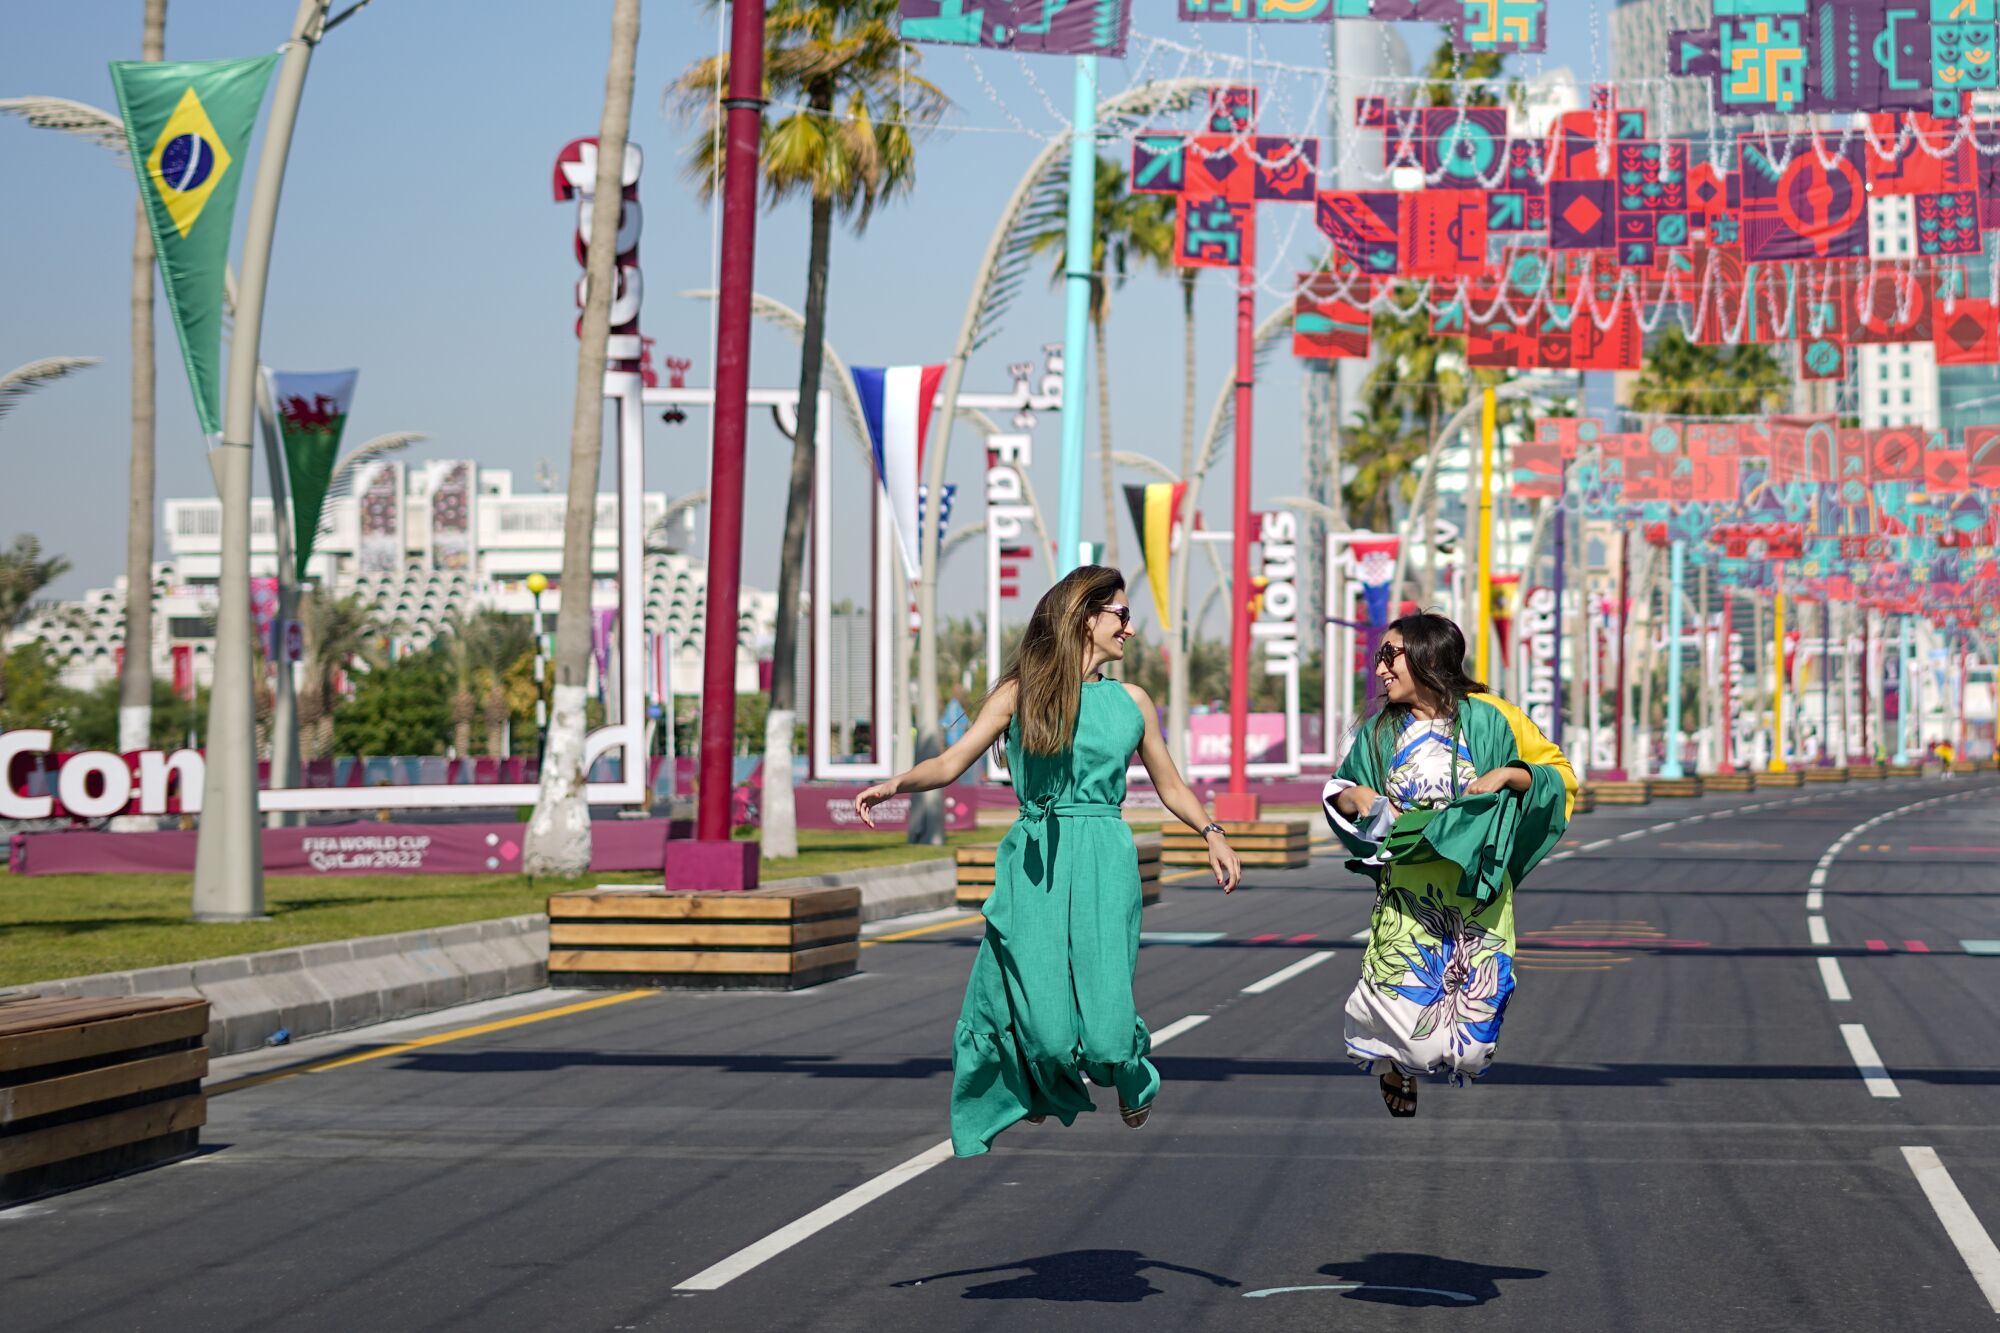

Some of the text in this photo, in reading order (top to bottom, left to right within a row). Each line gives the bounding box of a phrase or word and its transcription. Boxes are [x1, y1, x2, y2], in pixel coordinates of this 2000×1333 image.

[1250, 511, 1298, 676] ulous
[0, 729, 206, 819] Con
[302, 835, 432, 851] FIFA WORLD CUP
